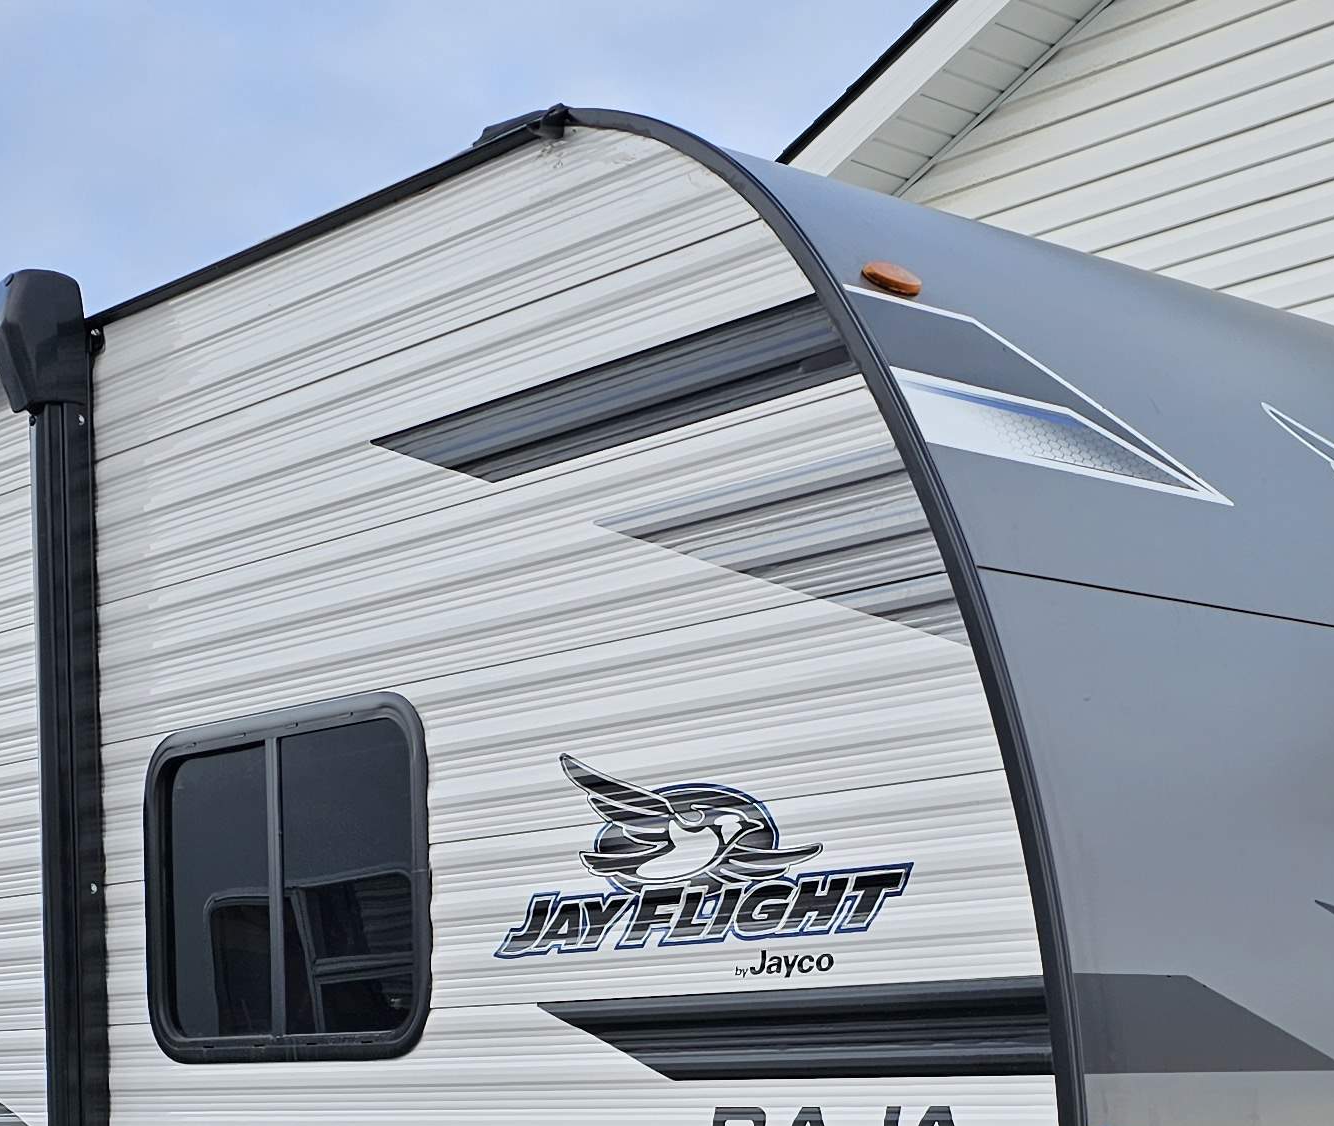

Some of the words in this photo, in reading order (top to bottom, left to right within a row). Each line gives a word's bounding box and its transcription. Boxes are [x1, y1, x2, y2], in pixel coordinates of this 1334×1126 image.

[494, 891, 634, 958] JAY
[615, 862, 914, 950] FLIGHT
[735, 965, 748, 978] by
[749, 949, 834, 978] Jayco
